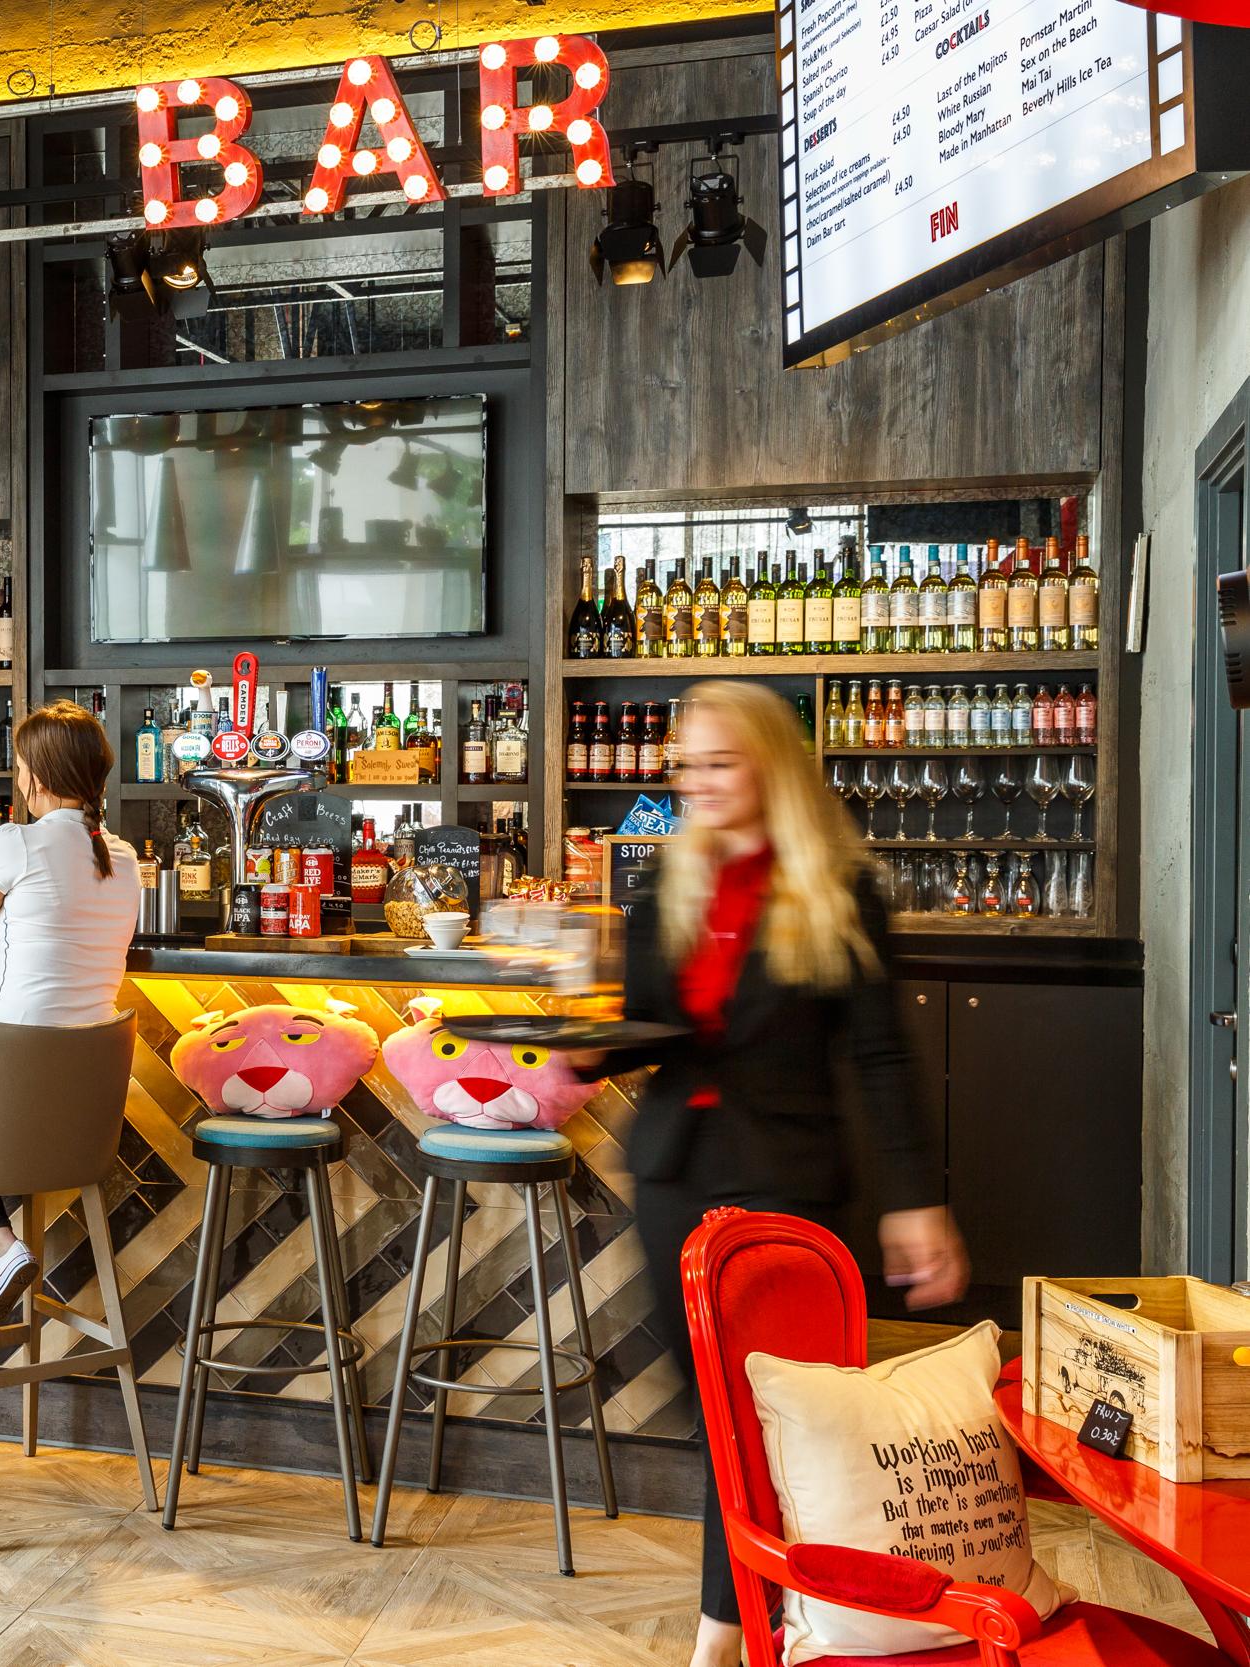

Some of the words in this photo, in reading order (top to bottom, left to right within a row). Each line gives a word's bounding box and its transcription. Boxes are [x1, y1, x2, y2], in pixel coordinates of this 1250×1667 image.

[801, 18, 816, 39] Fresh
[818, 0, 842, 26] Popcorn
[880, 5, 899, 27] £2.50
[915, 3, 933, 23] Pizza
[915, 19, 939, 41] Caesar
[941, 0, 961, 23] Salad
[1020, 20, 1057, 51] Pornstar
[1059, 0, 1093, 27] Martini
[881, 24, 899, 46] £4.95
[935, 9, 990, 59] COCKTAILS
[1020, 55, 1036, 73] Sex
[1038, 47, 1050, 62] on
[1052, 37, 1067, 54] the
[1069, 15, 1098, 43] Beach
[802, 44, 828, 71] Pick&Mix
[881, 43, 899, 65] £4.50
[802, 66, 819, 88] Salted
[820, 58, 833, 74] nuts
[803, 82, 823, 107] Spanish
[825, 66, 848, 88] Chorizo
[936, 86, 952, 103] Last
[954, 76, 962, 93] of
[963, 72, 976, 87] the
[978, 50, 1008, 77] Mojitos
[1021, 74, 1037, 95] Mai
[1038, 65, 1052, 84] Tai
[1022, 88, 1054, 116] Beverly
[1056, 75, 1077, 97] Hills
[1079, 67, 1093, 83] Ice
[1094, 56, 1112, 73] Tea
[803, 108, 817, 124] Soup
[818, 99, 825, 112] of
[825, 94, 835, 107] the
[836, 85, 847, 101] day
[892, 104, 911, 126] £4.50
[938, 101, 961, 123] White
[962, 83, 992, 109] Russian
[136, 33, 617, 231] BAR
[804, 117, 837, 153] DESSERTS
[893, 124, 911, 145] £4.50
[938, 120, 964, 144] Bloody
[966, 107, 985, 127] Mary
[939, 143, 959, 164] Made
[961, 139, 968, 151] in
[970, 113, 1012, 146] Manhattan
[805, 169, 819, 184] Fruit
[819, 155, 835, 175] Salad
[805, 179, 831, 202] Selection
[832, 171, 839, 185] of
[838, 168, 848, 180] ice
[848, 153, 871, 174] creams
[863, 169, 891, 196] caramel)
[894, 174, 913, 196] £4.50
[806, 235, 822, 249] Daim
[822, 226, 833, 239] Bar
[834, 218, 846, 232] tart
[930, 200, 959, 243] FIN
[265, 803, 293, 827] Craft
[316, 803, 347, 826] Beers
[620, 845, 655, 858] STOP
[181, 872, 197, 880] PINK
[303, 868, 321, 876] RED
[303, 876, 321, 885] RYE
[233, 913, 251, 922] IPA
[289, 919, 311, 930] APA
[1095, 1404, 1129, 1423] FRUIT
[870, 1436, 962, 1471] Working
[959, 1424, 1000, 1457] hard
[895, 1471, 914, 1495] is
[923, 1456, 1000, 1498] important
[882, 1499, 910, 1522] But
[916, 1493, 949, 1517] there
[956, 1493, 968, 1512] is
[974, 1481, 1021, 1508] something
[901, 1522, 925, 1541] that
[931, 1518, 969, 1536] matters
[973, 1517, 993, 1531] even
[962, 1540, 974, 1558] in
